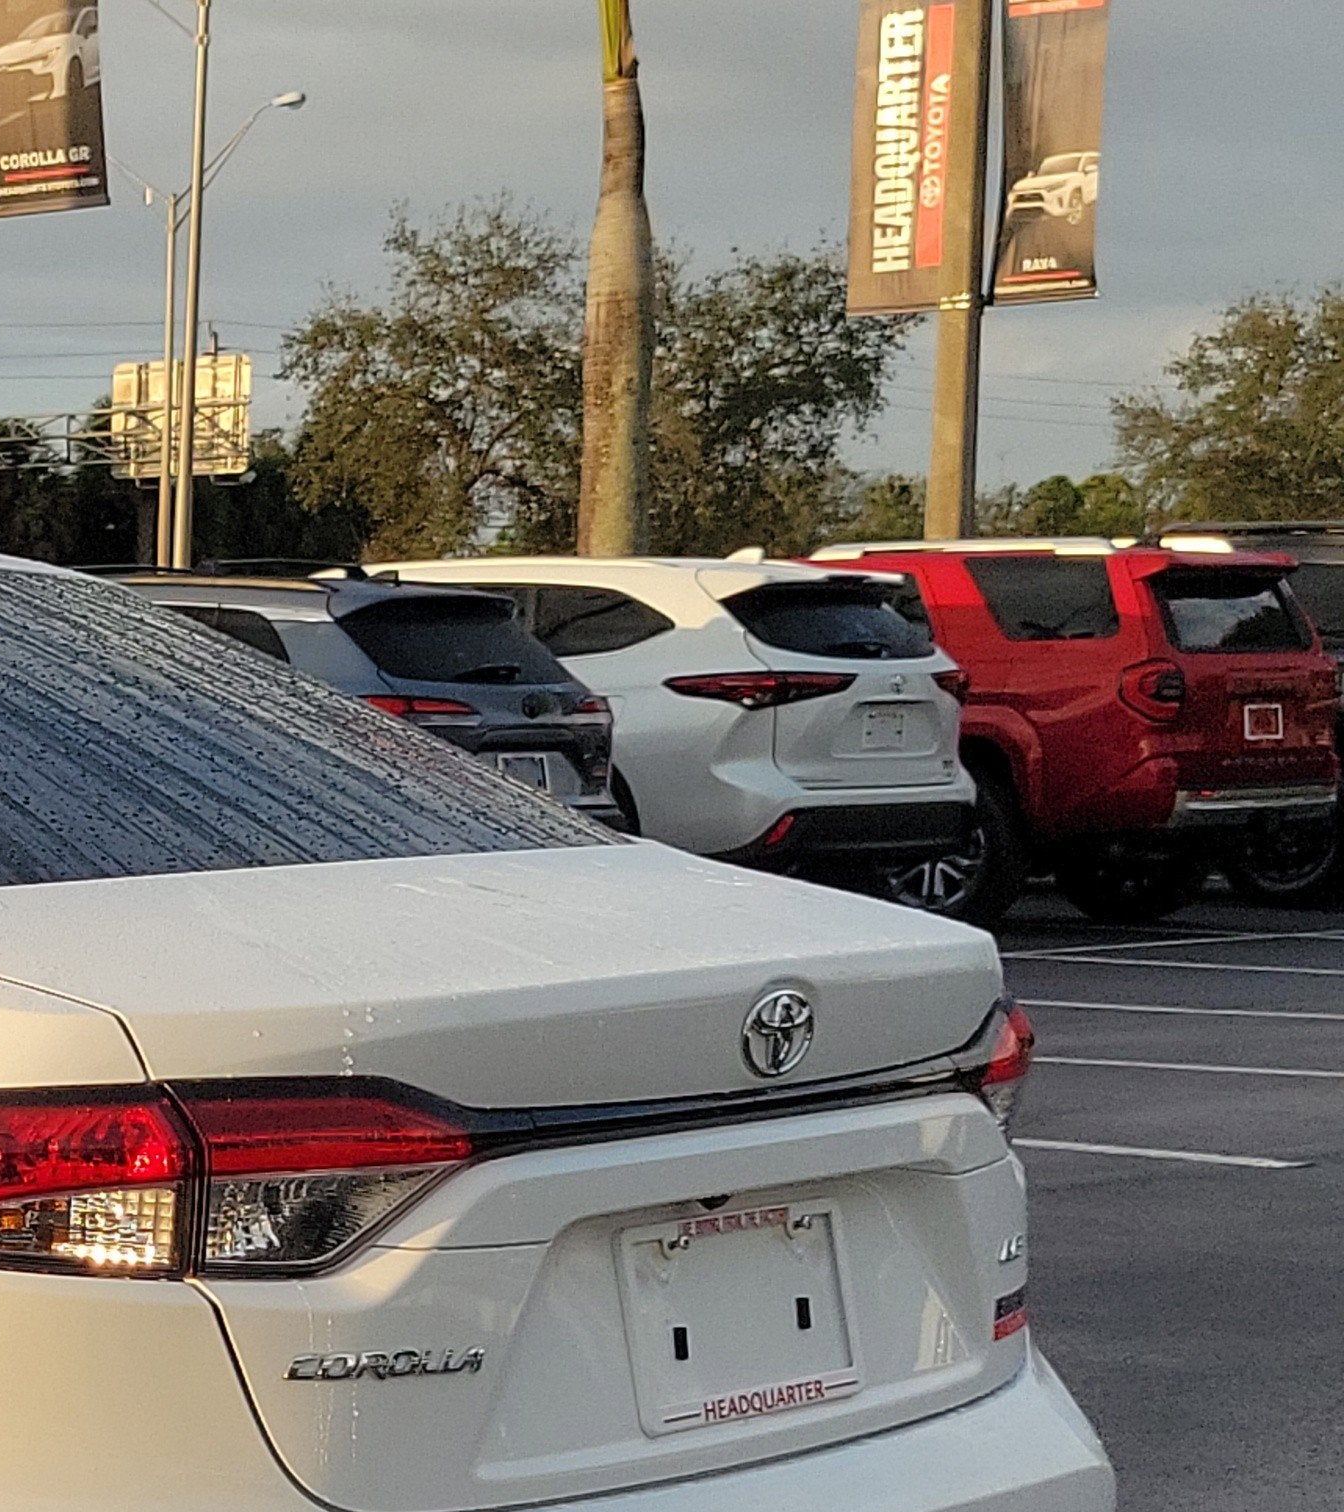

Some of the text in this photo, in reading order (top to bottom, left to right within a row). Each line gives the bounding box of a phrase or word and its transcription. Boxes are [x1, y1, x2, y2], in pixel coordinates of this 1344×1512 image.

[872, 9, 924, 273] HEADQUARTER
[923, 73, 952, 176] TOYOTA
[0, 145, 91, 171] COROLLA GR
[283, 1345, 486, 1381] COROLLA
[703, 1379, 826, 1422] HEADQUARTER
